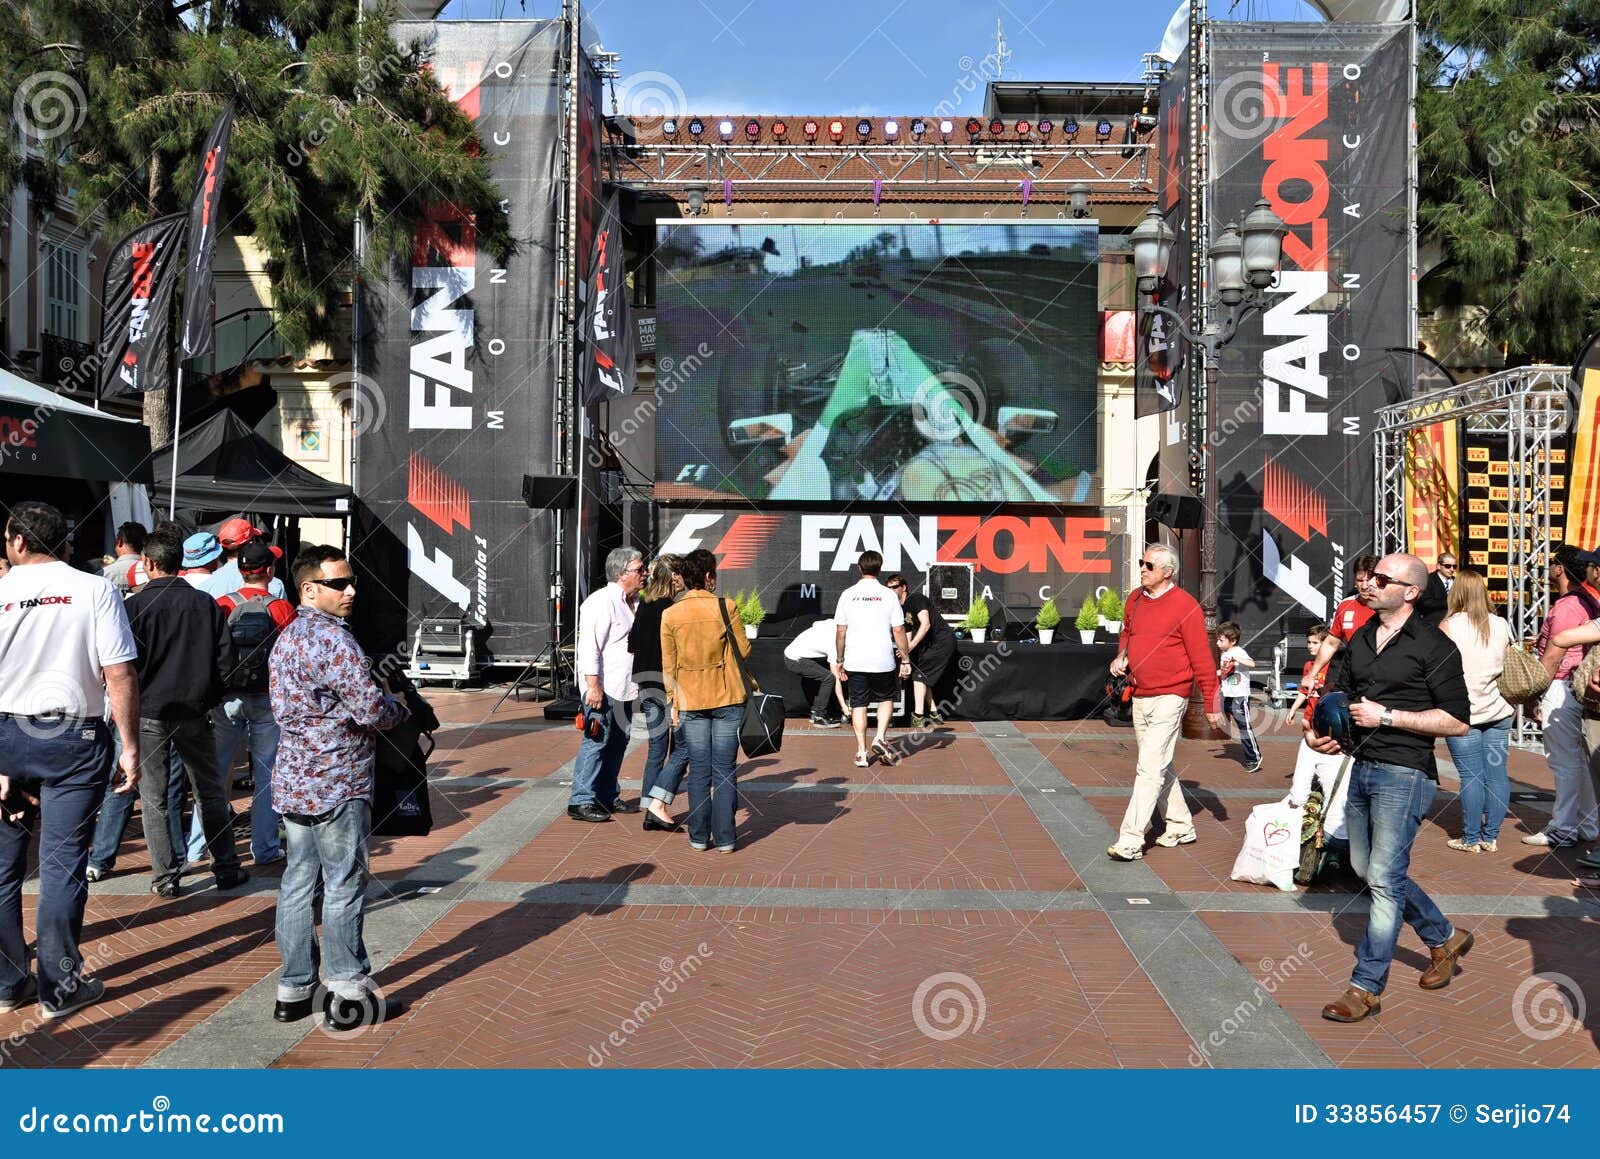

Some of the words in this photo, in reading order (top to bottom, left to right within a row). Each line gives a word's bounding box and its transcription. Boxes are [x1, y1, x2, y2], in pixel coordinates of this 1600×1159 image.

[1261, 62, 1330, 436] FANZONE
[474, 534, 487, 549] 1
[801, 514, 1112, 574] FANZONE
[1331, 541, 1344, 556] 1
[20, 596, 72, 609] FANZONE
[474, 550, 487, 626] Formula
